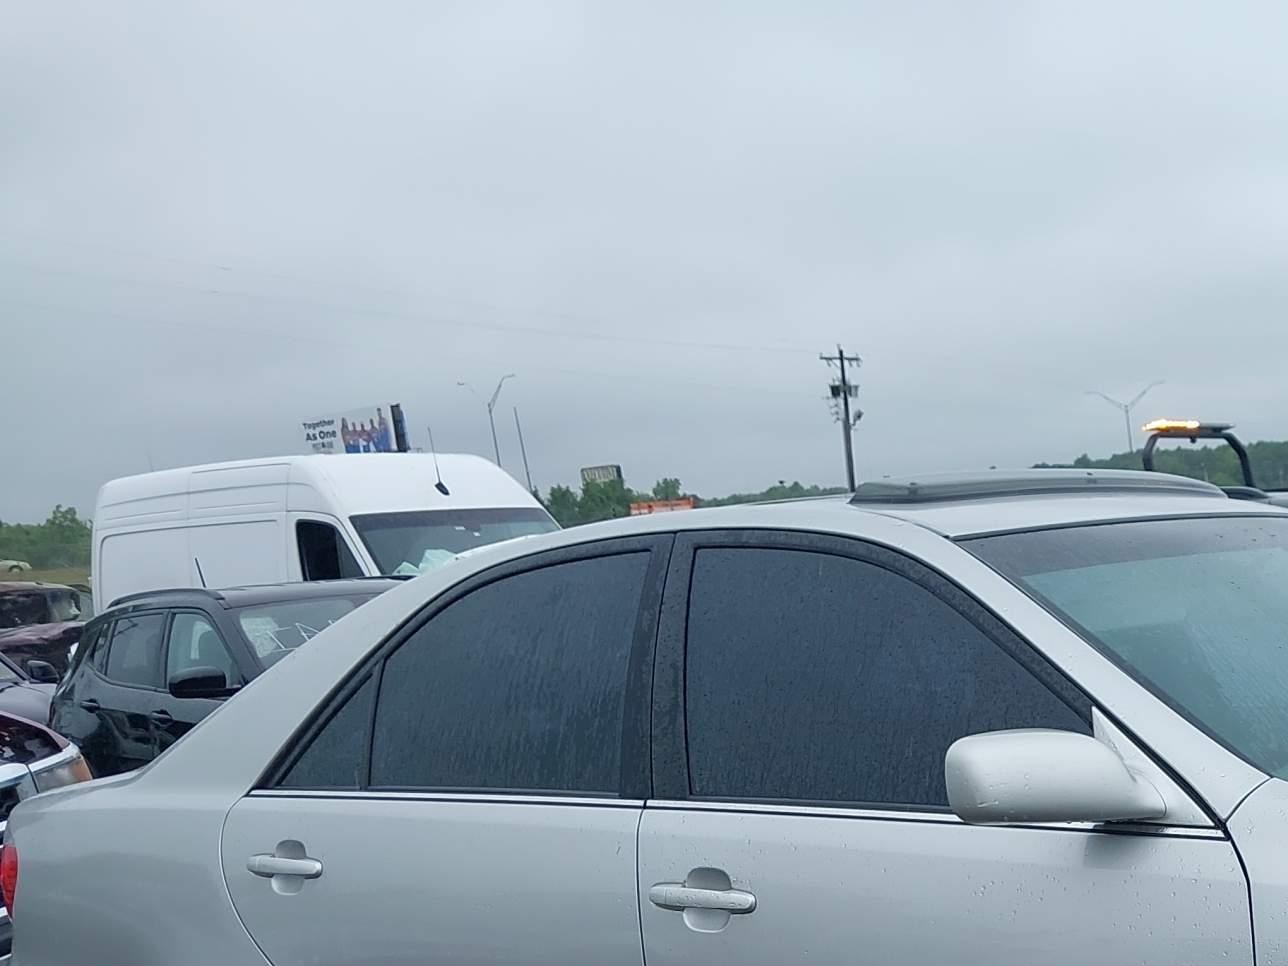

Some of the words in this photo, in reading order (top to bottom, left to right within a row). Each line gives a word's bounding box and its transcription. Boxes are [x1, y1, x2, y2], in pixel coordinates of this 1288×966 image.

[302, 419, 335, 430] Together
[305, 432, 317, 441] As
[318, 430, 337, 440] One
